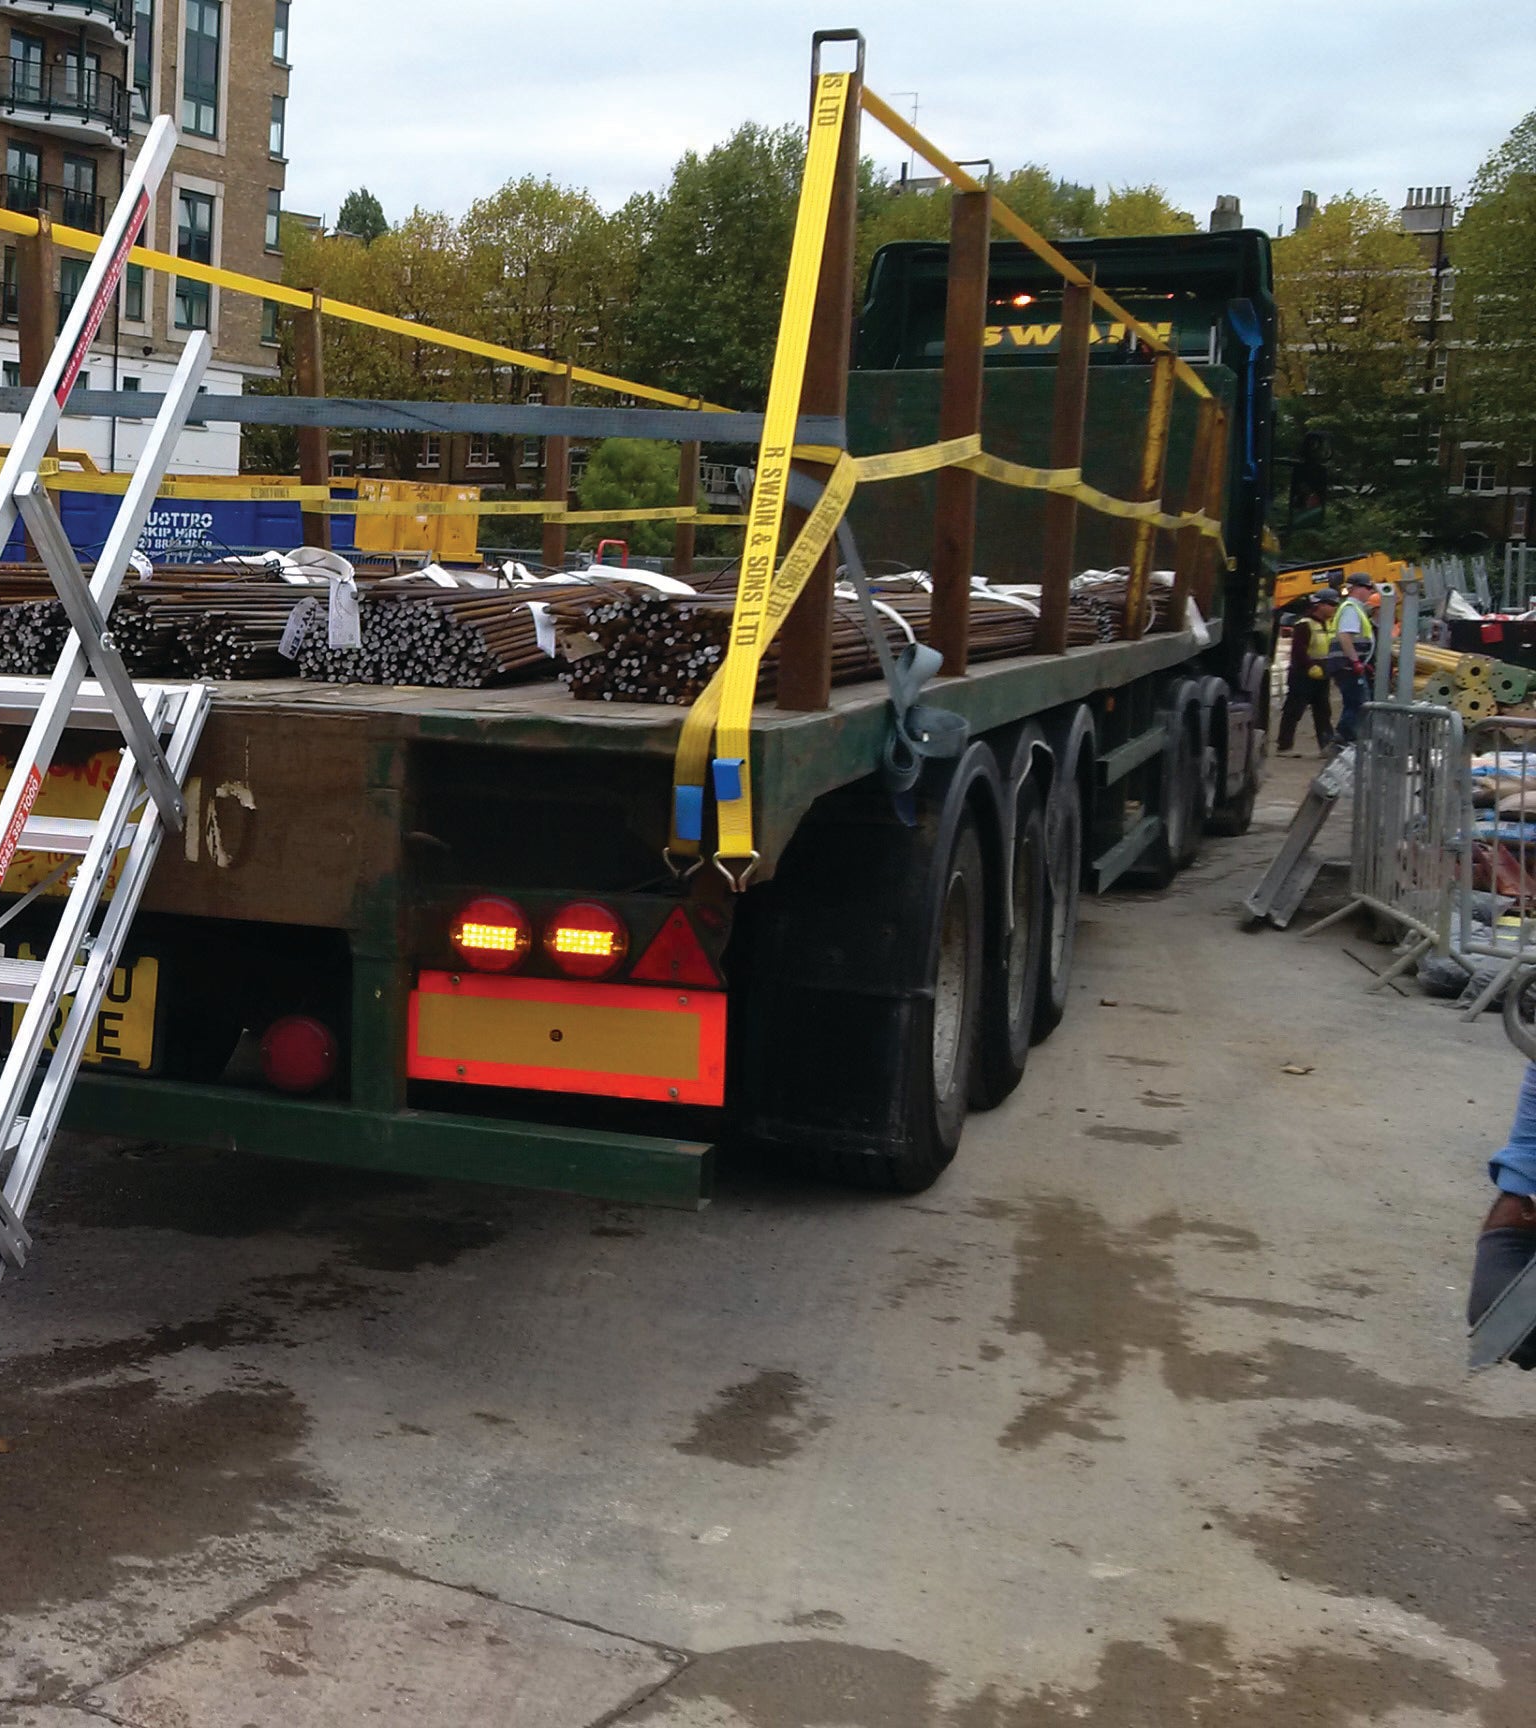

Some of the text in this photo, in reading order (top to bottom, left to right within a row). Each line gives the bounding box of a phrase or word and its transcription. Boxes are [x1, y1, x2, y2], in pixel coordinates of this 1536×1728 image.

[817, 95, 841, 126] LTD
[735, 446, 786, 646] R SWAIN & SONS LTD
[13, 812, 25, 840] 382
[23, 779, 38, 811] 1000
